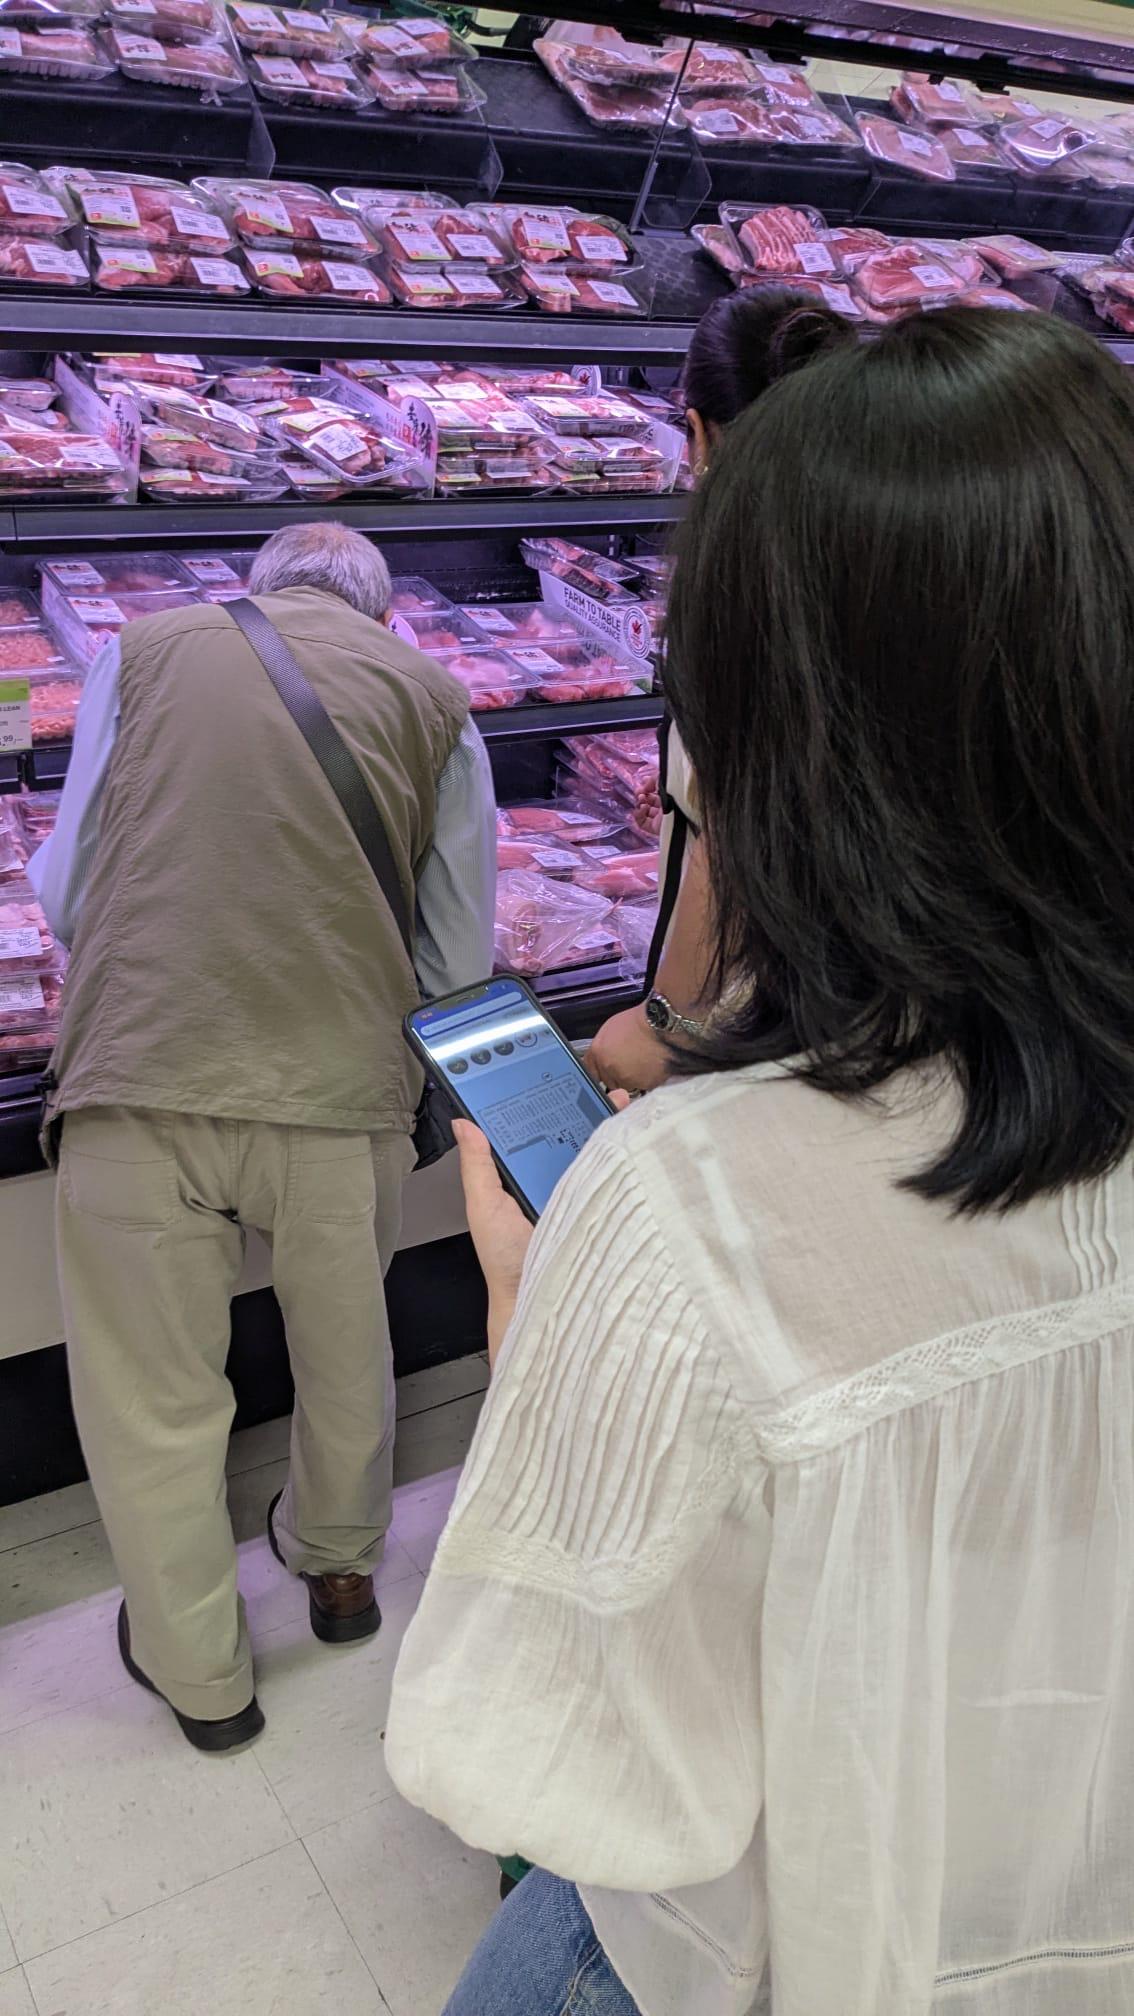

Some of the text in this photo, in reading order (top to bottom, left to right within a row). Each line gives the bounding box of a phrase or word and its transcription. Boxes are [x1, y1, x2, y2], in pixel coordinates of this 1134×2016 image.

[564, 587, 585, 608] FARM
[586, 600, 597, 614] TO
[598, 607, 621, 632] TABLE
[565, 599, 587, 619] QUALITY
[588, 615, 621, 642] ASSURANCE
